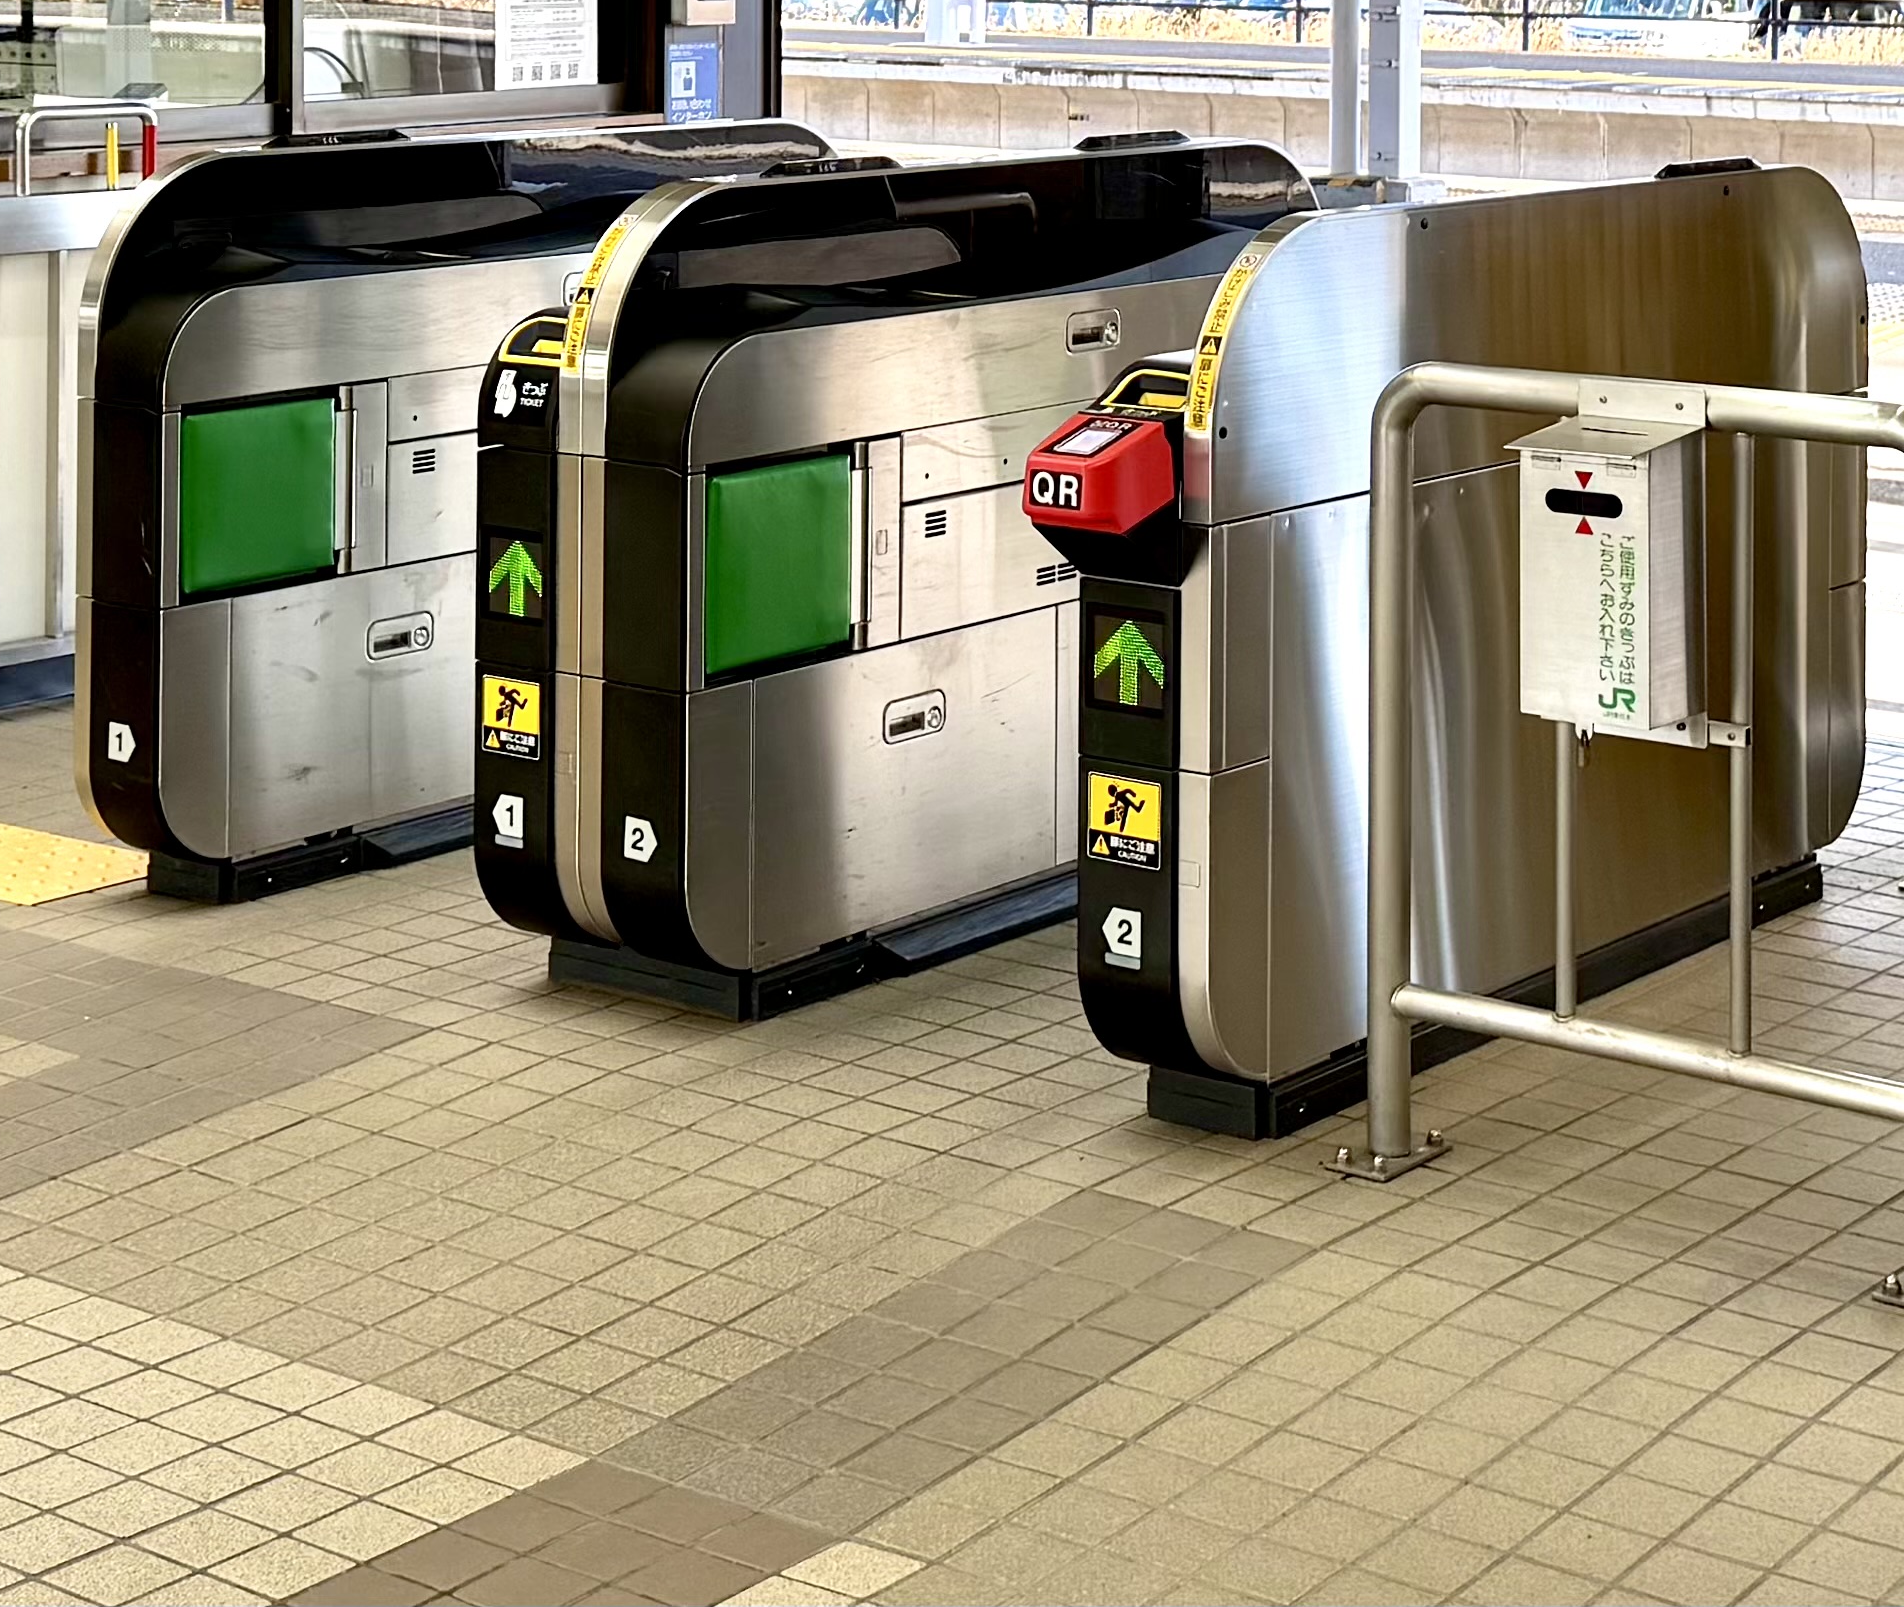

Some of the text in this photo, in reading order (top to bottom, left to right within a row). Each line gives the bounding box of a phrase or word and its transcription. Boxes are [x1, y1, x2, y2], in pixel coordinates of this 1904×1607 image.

[522, 382, 549, 397] きっぷ
[1032, 471, 1079, 507] QR
[1599, 532, 1616, 682] こちらへお入れ下さい
[1619, 535, 1636, 685] ご使用ずみのきっぷは
[1598, 687, 1636, 713] JR
[116, 732, 123, 752] 1
[506, 804, 514, 827] 1
[630, 827, 645, 852] 2
[1117, 919, 1133, 946] 2
